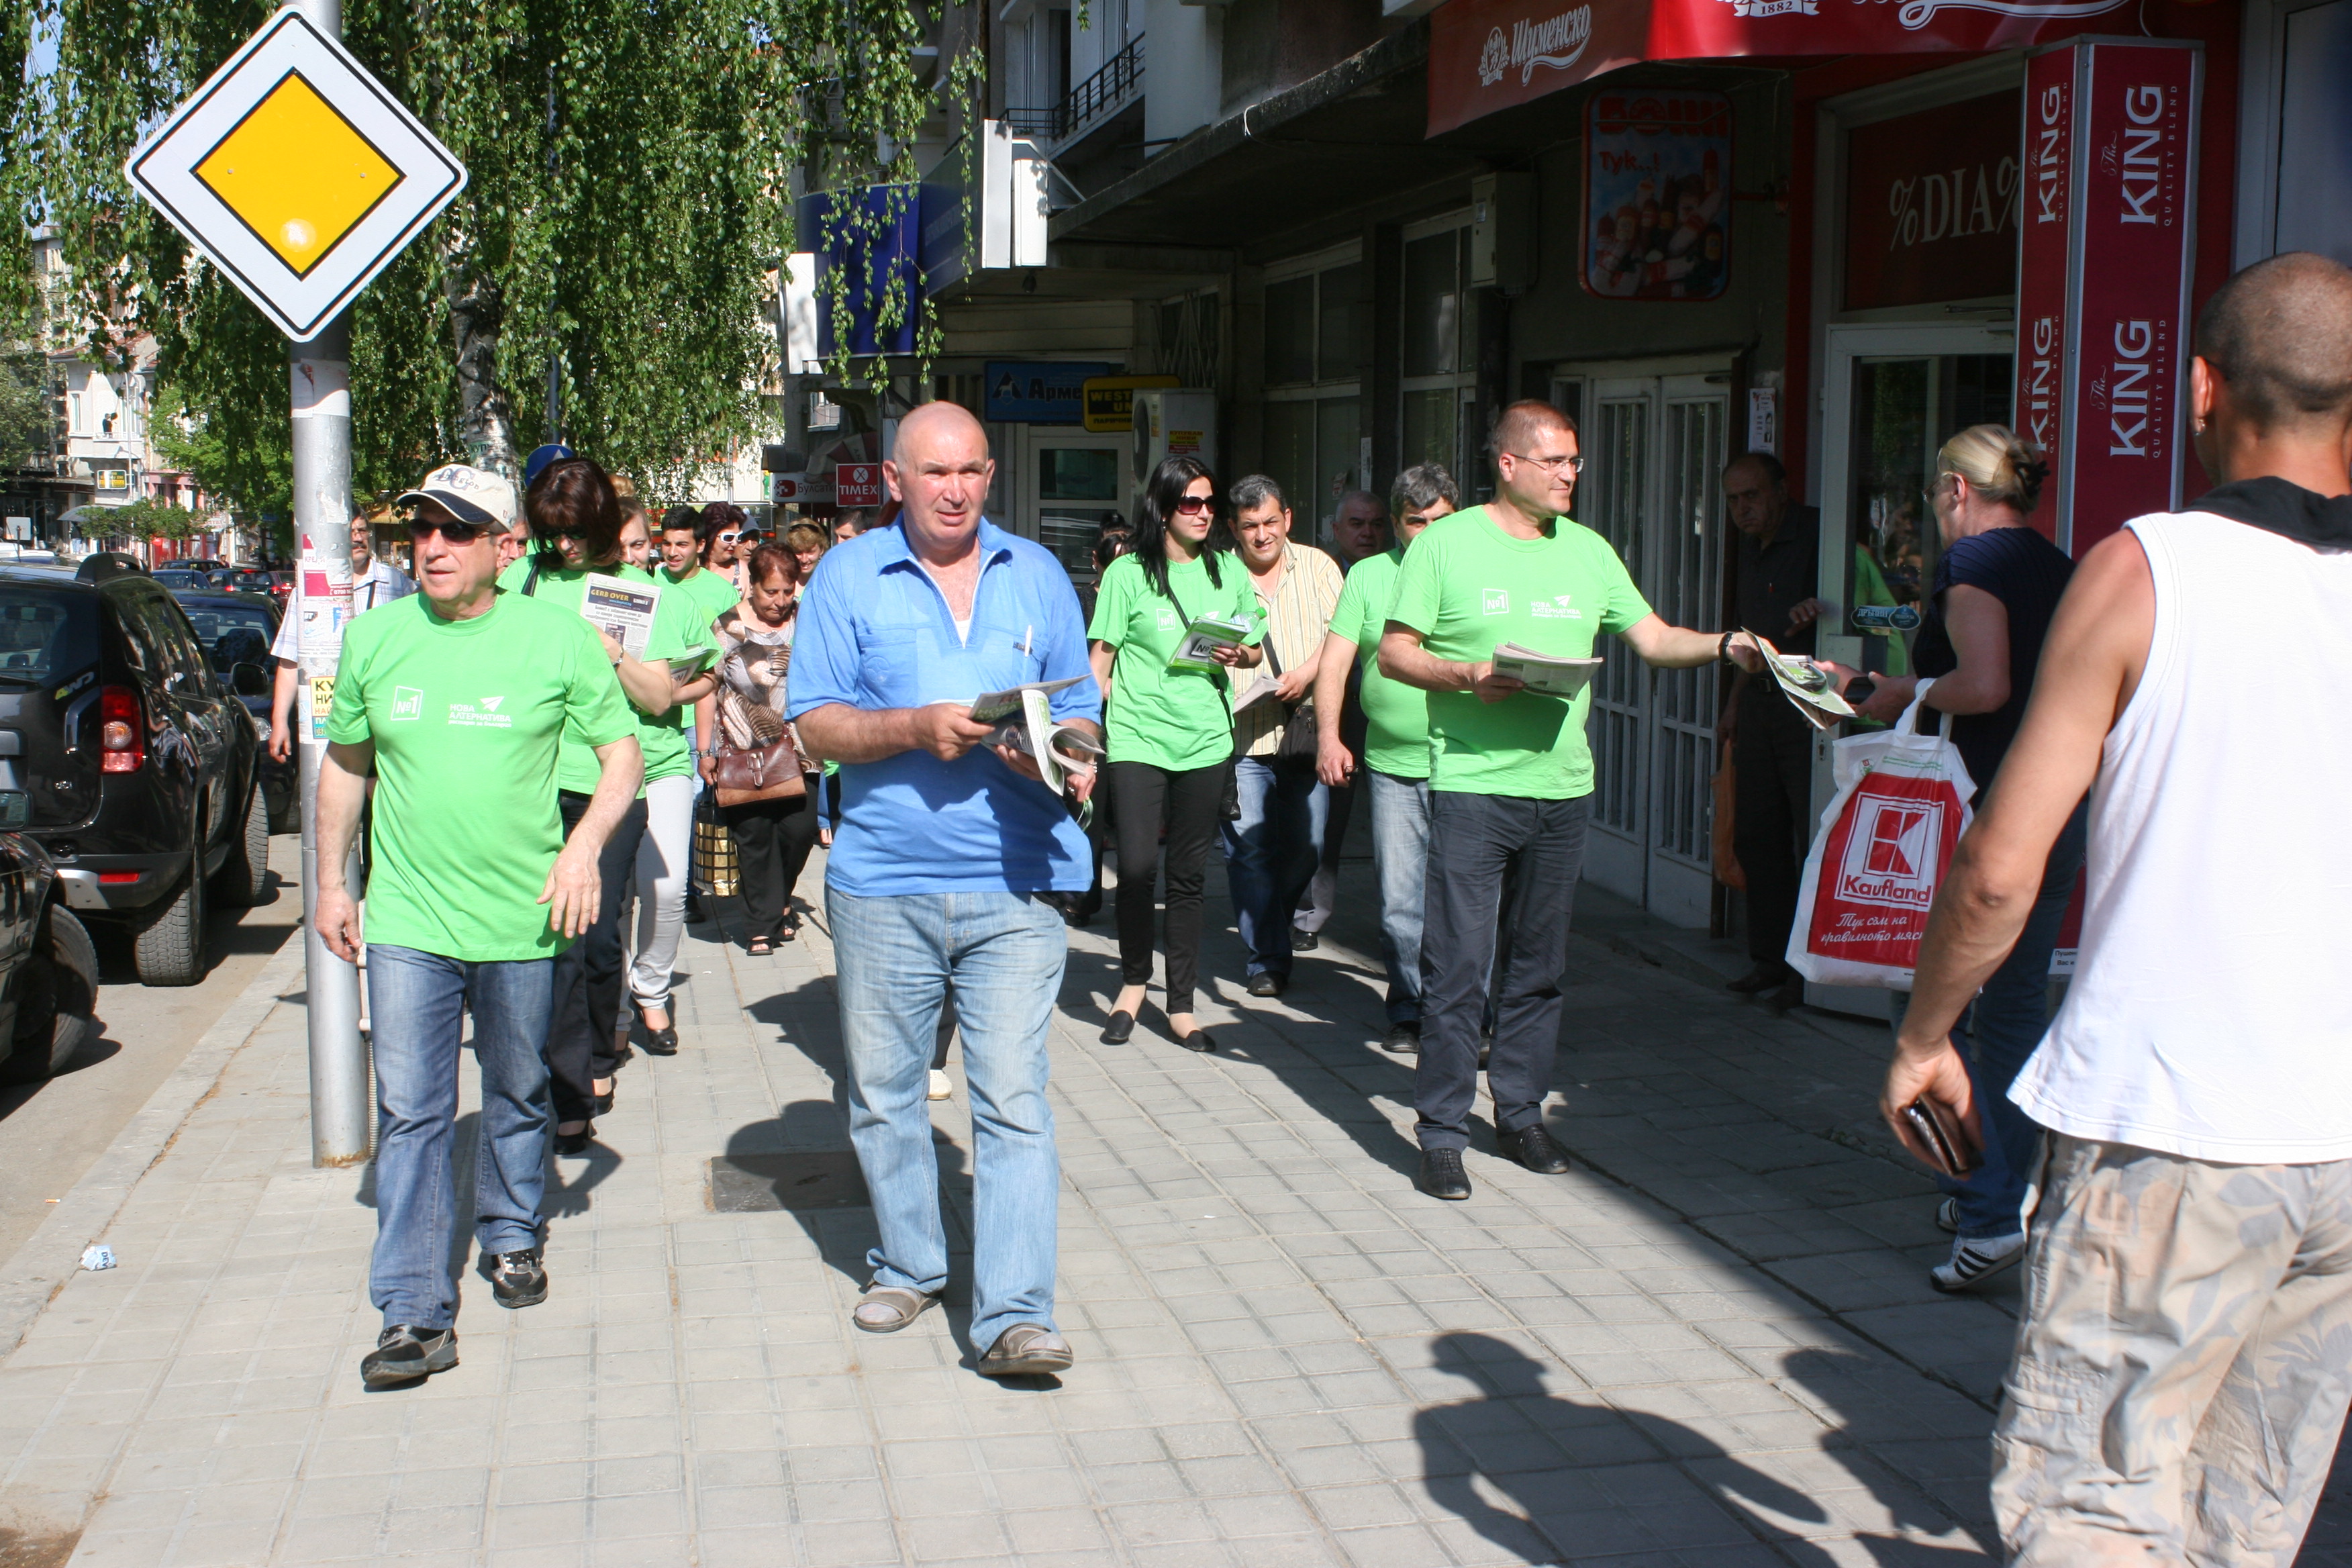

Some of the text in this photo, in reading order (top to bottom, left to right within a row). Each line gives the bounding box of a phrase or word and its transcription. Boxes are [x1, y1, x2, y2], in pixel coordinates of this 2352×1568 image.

[1761, 1, 1793, 15] 1882
[1511, 4, 1591, 84] Шуменско
[2038, 84, 2061, 224] KING
[2120, 83, 2163, 226] KING
[2157, 85, 2177, 227] QUALITY BLEND
[2110, 317, 2153, 458] KING
[2153, 320, 2167, 458] QUALITY BLEND
[2049, 380, 2057, 454] QUALITY
[839, 485, 878, 495] TIMEX
[609, 592, 629, 601] OVER
[448, 711, 511, 722] АЛТЕРНАТИВА
[449, 703, 475, 713] НОВА
[1845, 875, 1932, 903] Kaufland
[1835, 913, 1865, 931] Тук
[1890, 916, 1908, 925] на
